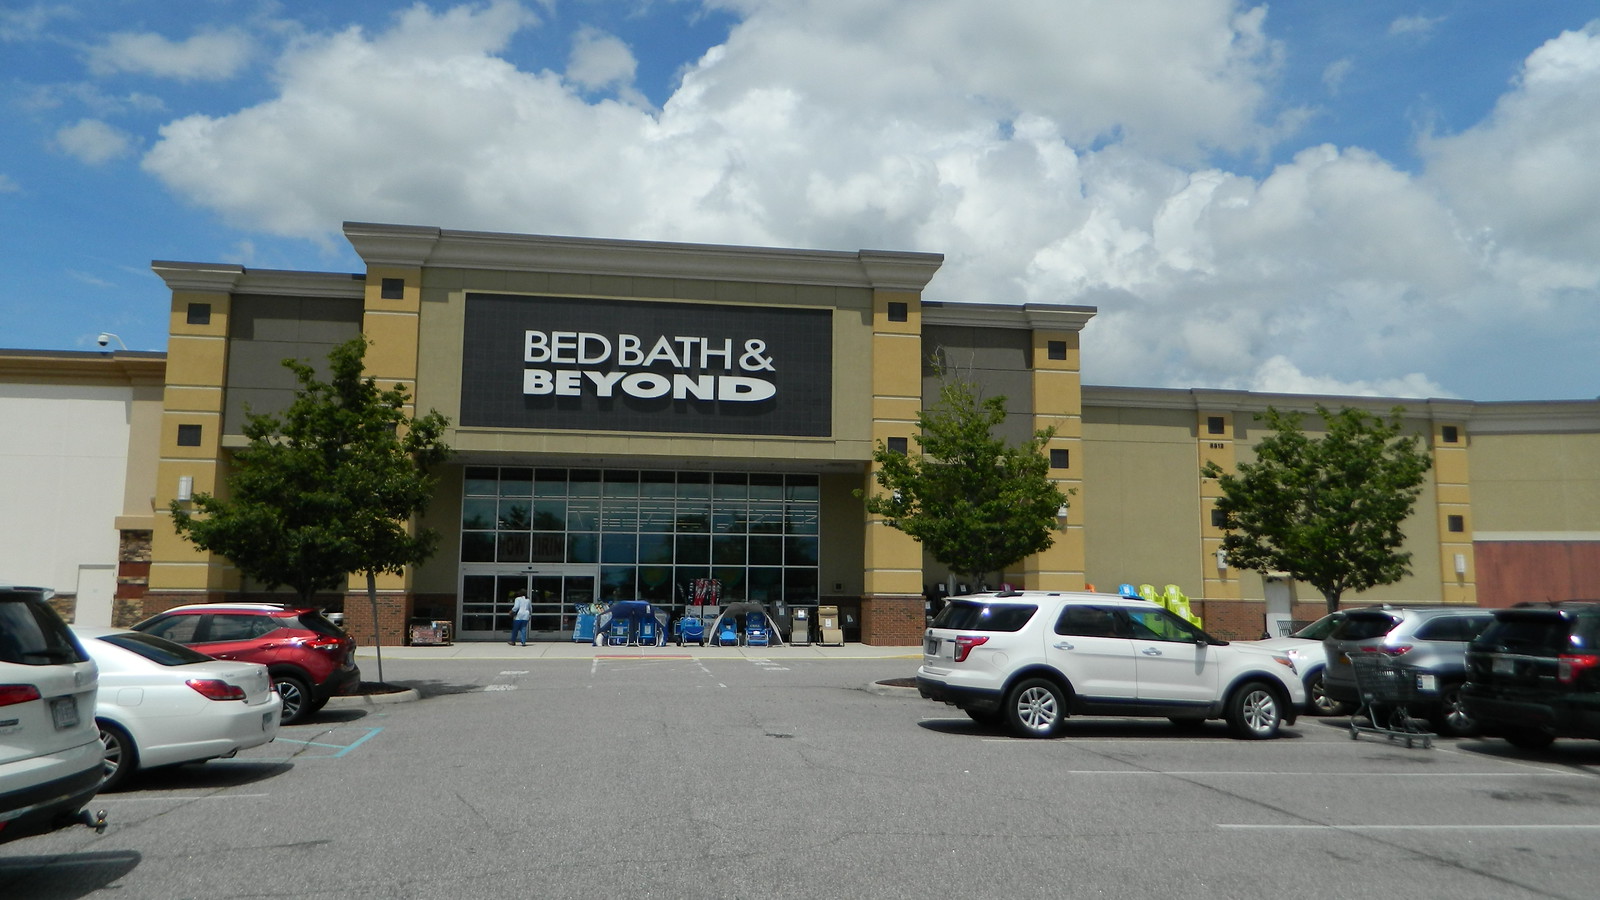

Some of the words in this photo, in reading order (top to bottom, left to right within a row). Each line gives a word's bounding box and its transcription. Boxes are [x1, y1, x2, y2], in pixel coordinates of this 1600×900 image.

[524, 330, 612, 365] BED
[618, 333, 732, 370] BATH
[738, 338, 776, 372] &
[523, 369, 777, 401] BEYOND
